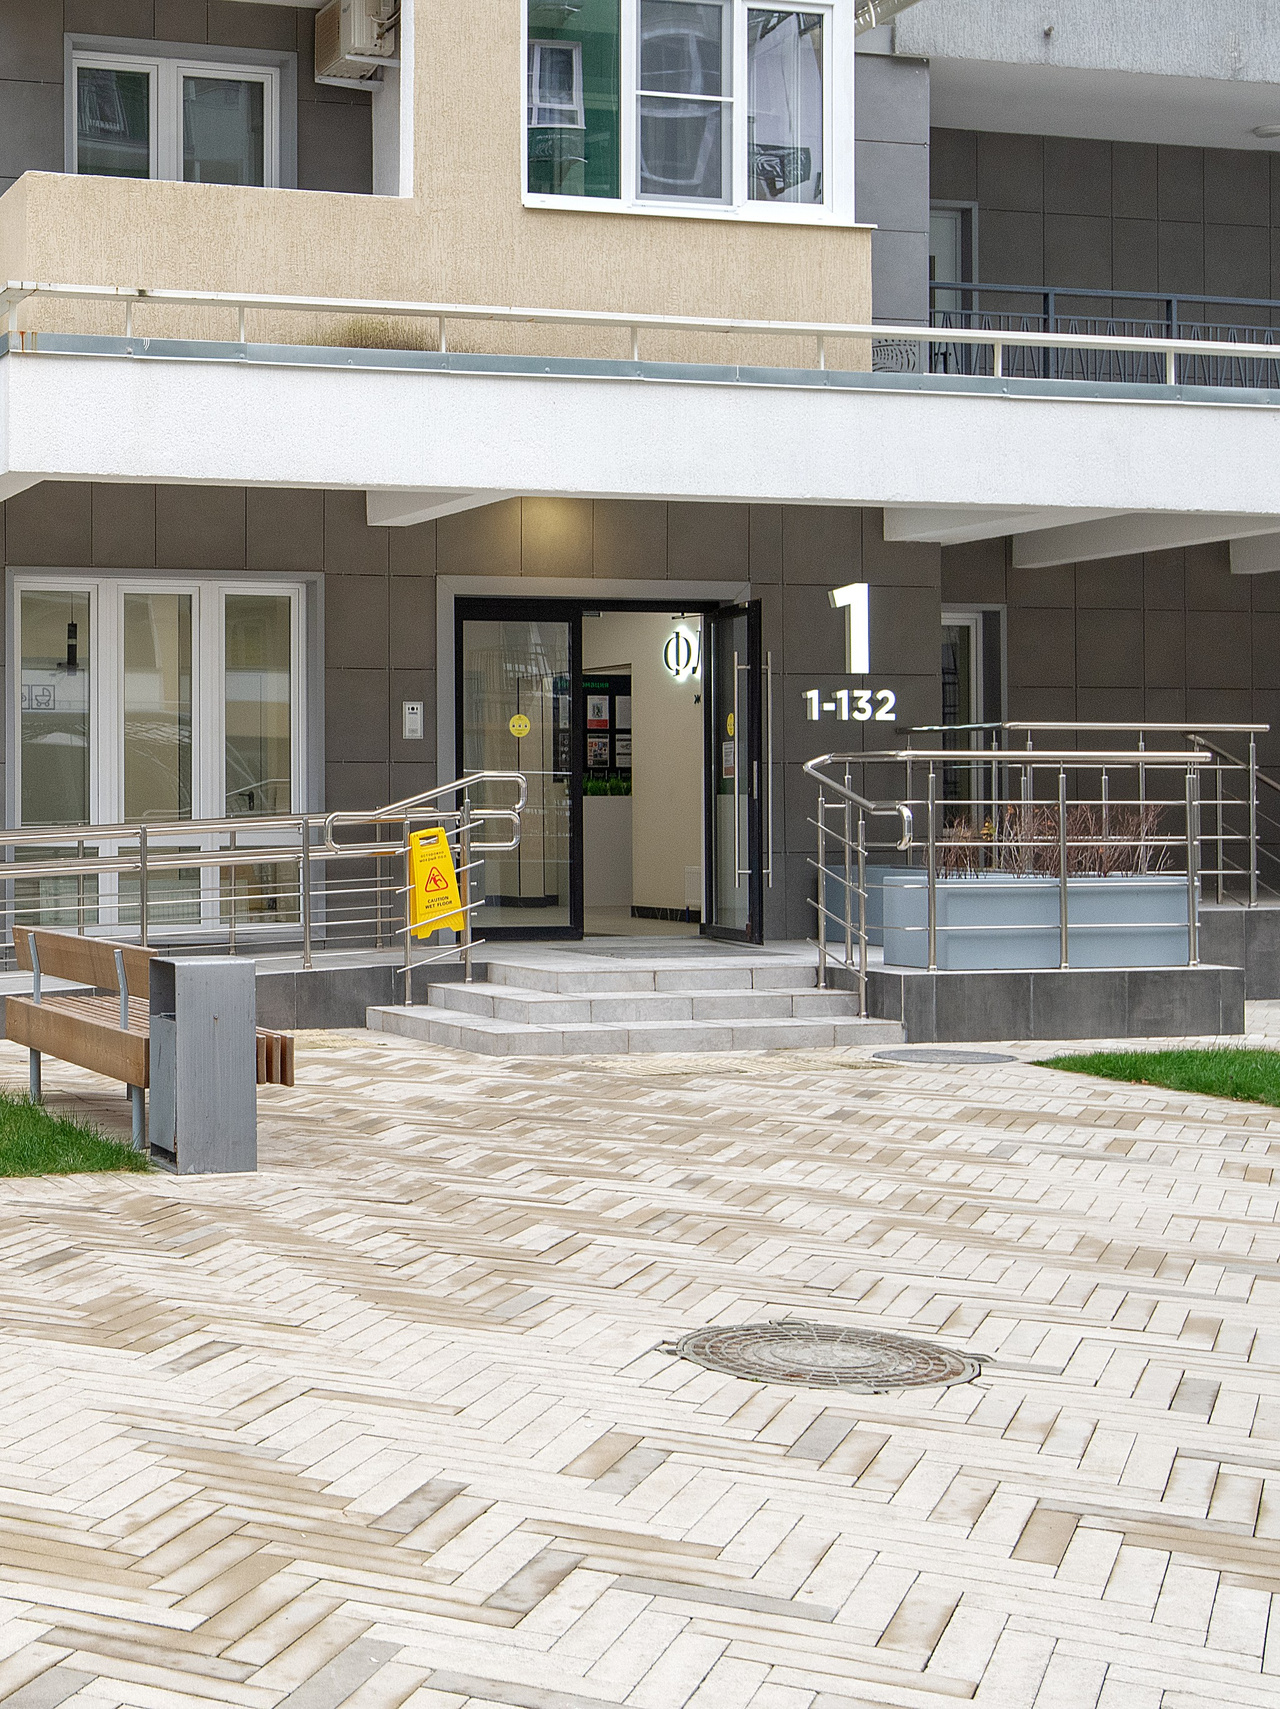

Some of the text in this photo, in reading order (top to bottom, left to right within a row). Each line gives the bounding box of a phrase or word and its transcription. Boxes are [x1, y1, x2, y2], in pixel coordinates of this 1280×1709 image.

[828, 583, 870, 674] 1
[801, 689, 896, 721] 1-132
[427, 896, 449, 904] CAUTION
